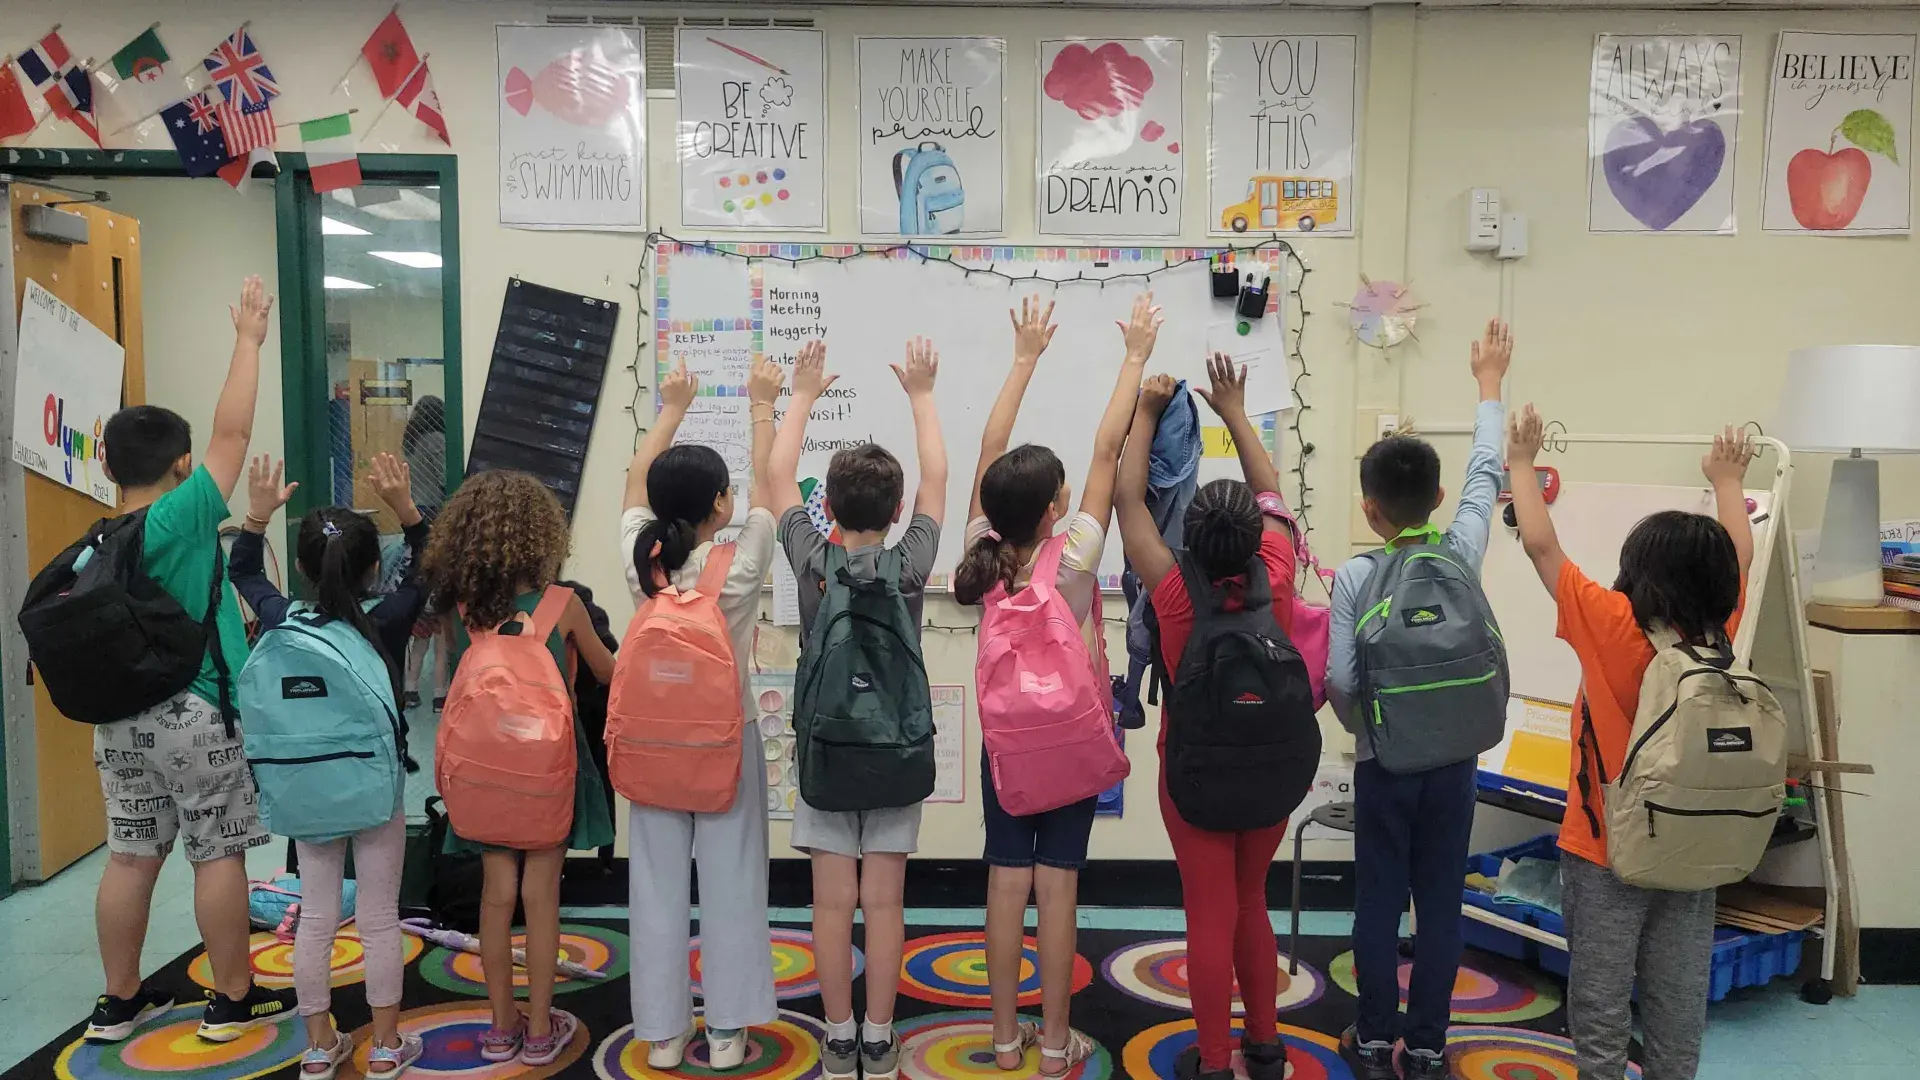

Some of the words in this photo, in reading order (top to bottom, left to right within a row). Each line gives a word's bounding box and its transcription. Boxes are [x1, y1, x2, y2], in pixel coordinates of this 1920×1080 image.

[899, 47, 953, 85] MAKE
[1252, 39, 1319, 97] YOU
[1606, 42, 1730, 100] ALWAYS
[1780, 53, 1910, 80] BELIEVE
[722, 81, 753, 119] BE
[878, 86, 974, 122] YOURSELF
[1804, 71, 1892, 111] yourself
[1257, 94, 1314, 121] got
[693, 121, 808, 159] CREATIVE
[872, 105, 996, 145] proud
[509, 146, 568, 170] just
[577, 141, 632, 169] keep
[1250, 113, 1318, 170] THIS
[519, 161, 632, 201] SWIMMING
[1125, 164, 1177, 175] your
[30, 285, 57, 316] WELCOME
[59, 304, 69, 323] TO
[69, 311, 81, 332] THE
[769, 287, 820, 304] Morning
[770, 303, 822, 320] Meeting
[675, 334, 716, 344] REFLEX
[770, 323, 828, 341] Heggerty
[13, 441, 48, 471] CHARLESTOWN
[93, 483, 109, 502] 2024
[155, 710, 204, 731] CONVERSE
[251, 1000, 283, 1016] PUMA
